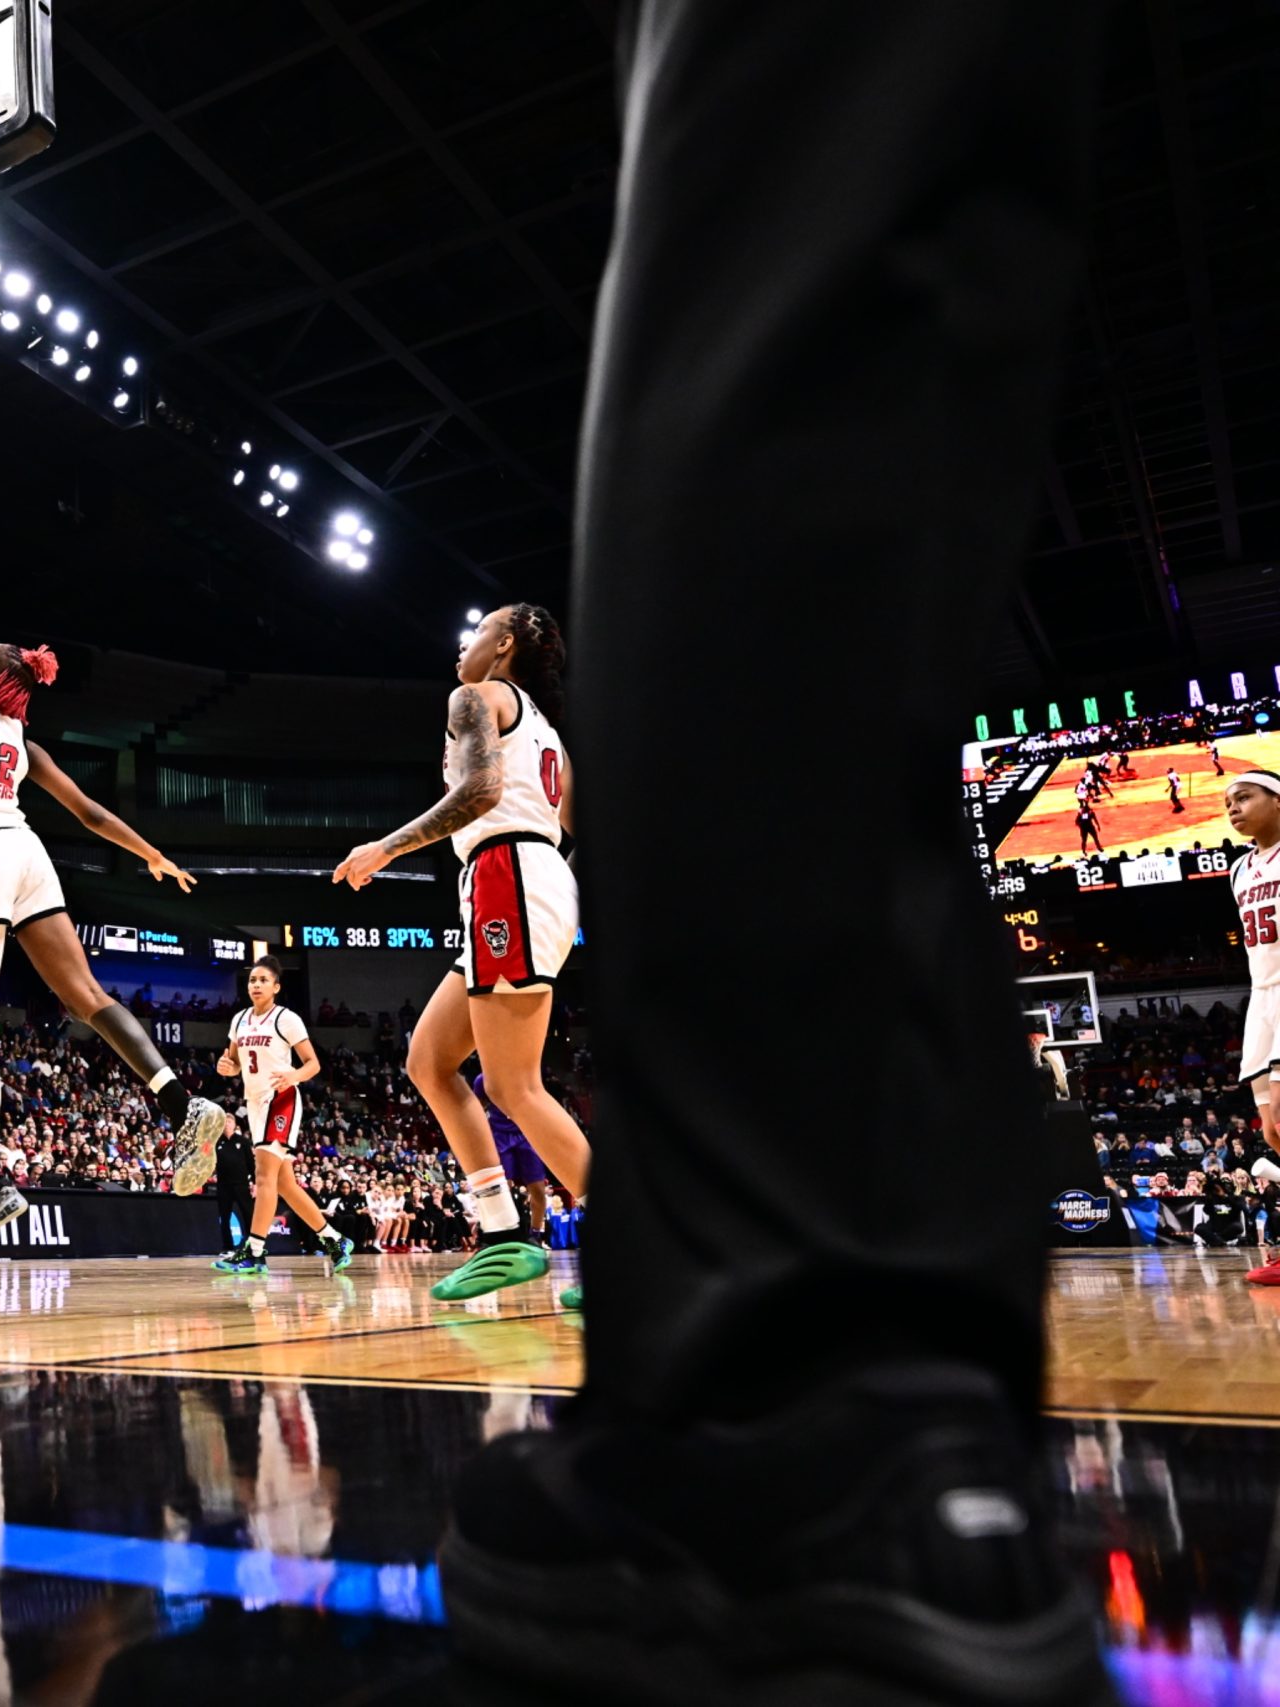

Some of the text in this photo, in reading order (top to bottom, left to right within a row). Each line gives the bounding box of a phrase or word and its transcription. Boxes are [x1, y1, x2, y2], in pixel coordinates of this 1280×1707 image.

[1197, 852, 1228, 873] 66
[1076, 866, 1105, 887] 62
[1247, 880, 1280, 904] STAT
[1004, 909, 1039, 926] 4:40
[1243, 904, 1279, 948] 35
[303, 926, 340, 948] FG%
[346, 927, 380, 948] 38.8
[387, 928, 434, 949] 3PT%
[155, 1022, 181, 1044] 113
[245, 1035, 273, 1047] STATE
[248, 1050, 259, 1074] 3
[1059, 1201, 1091, 1211] MARCH
[1064, 1209, 1108, 1220] MADNESS
[28, 1204, 70, 1246] ALL
